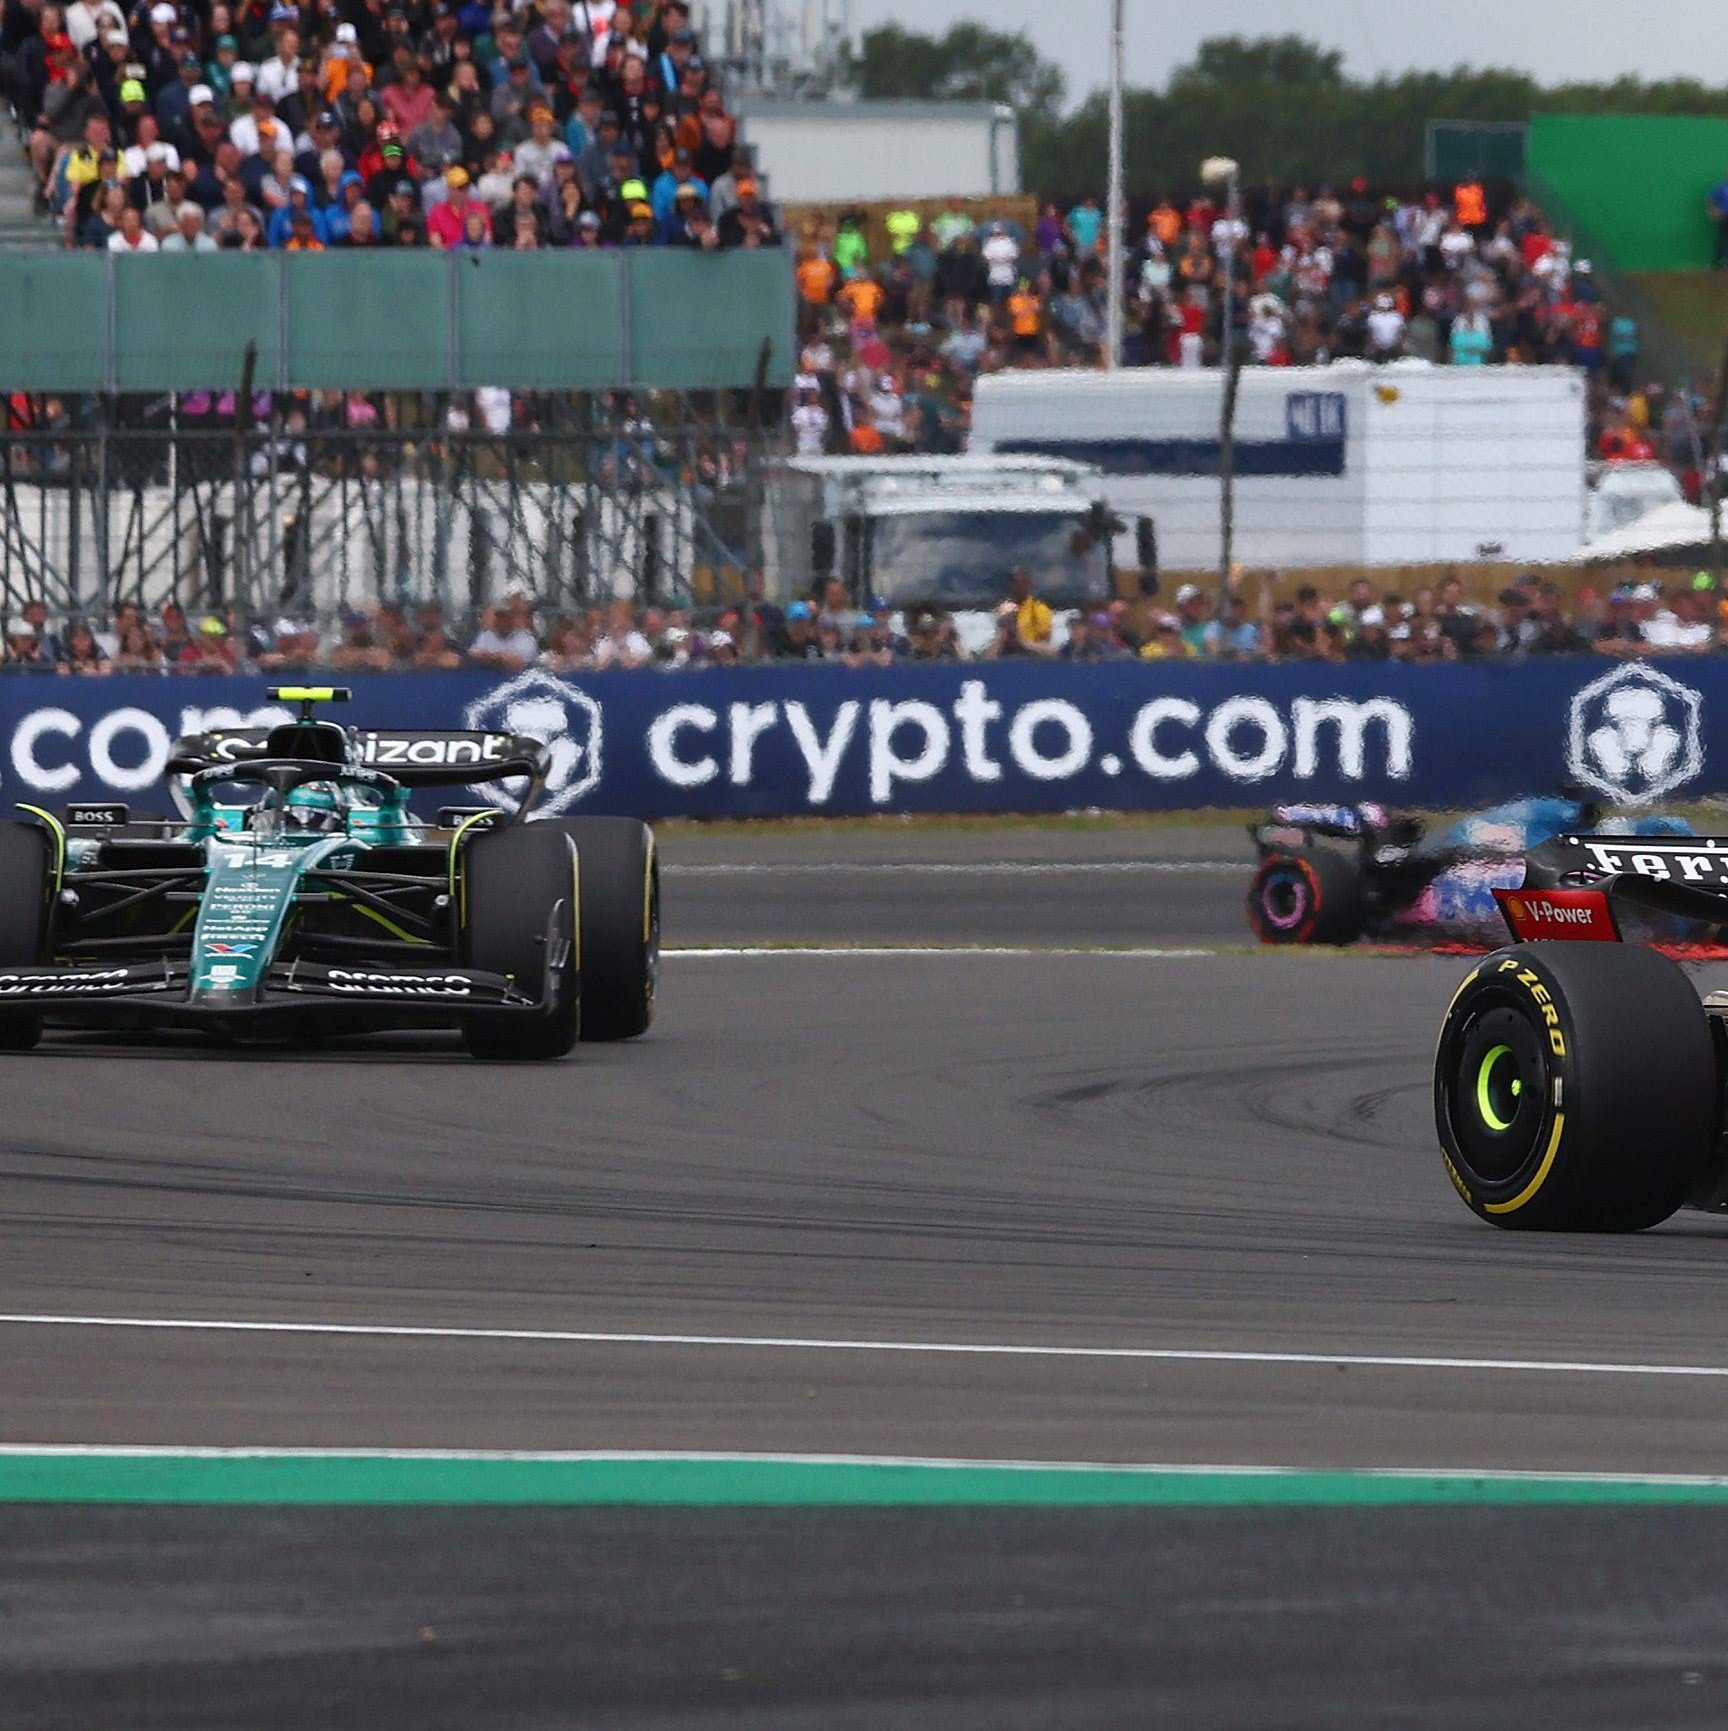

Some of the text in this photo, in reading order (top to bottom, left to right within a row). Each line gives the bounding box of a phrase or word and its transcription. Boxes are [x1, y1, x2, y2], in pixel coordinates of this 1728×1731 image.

[646, 679, 1413, 803] crypto.com
[74, 811, 114, 822] BOSS
[224, 853, 293, 868] 14
[1525, 900, 1592, 924] V-Power
[1498, 959, 1519, 973] P
[1516, 968, 1567, 1058] ZERO
